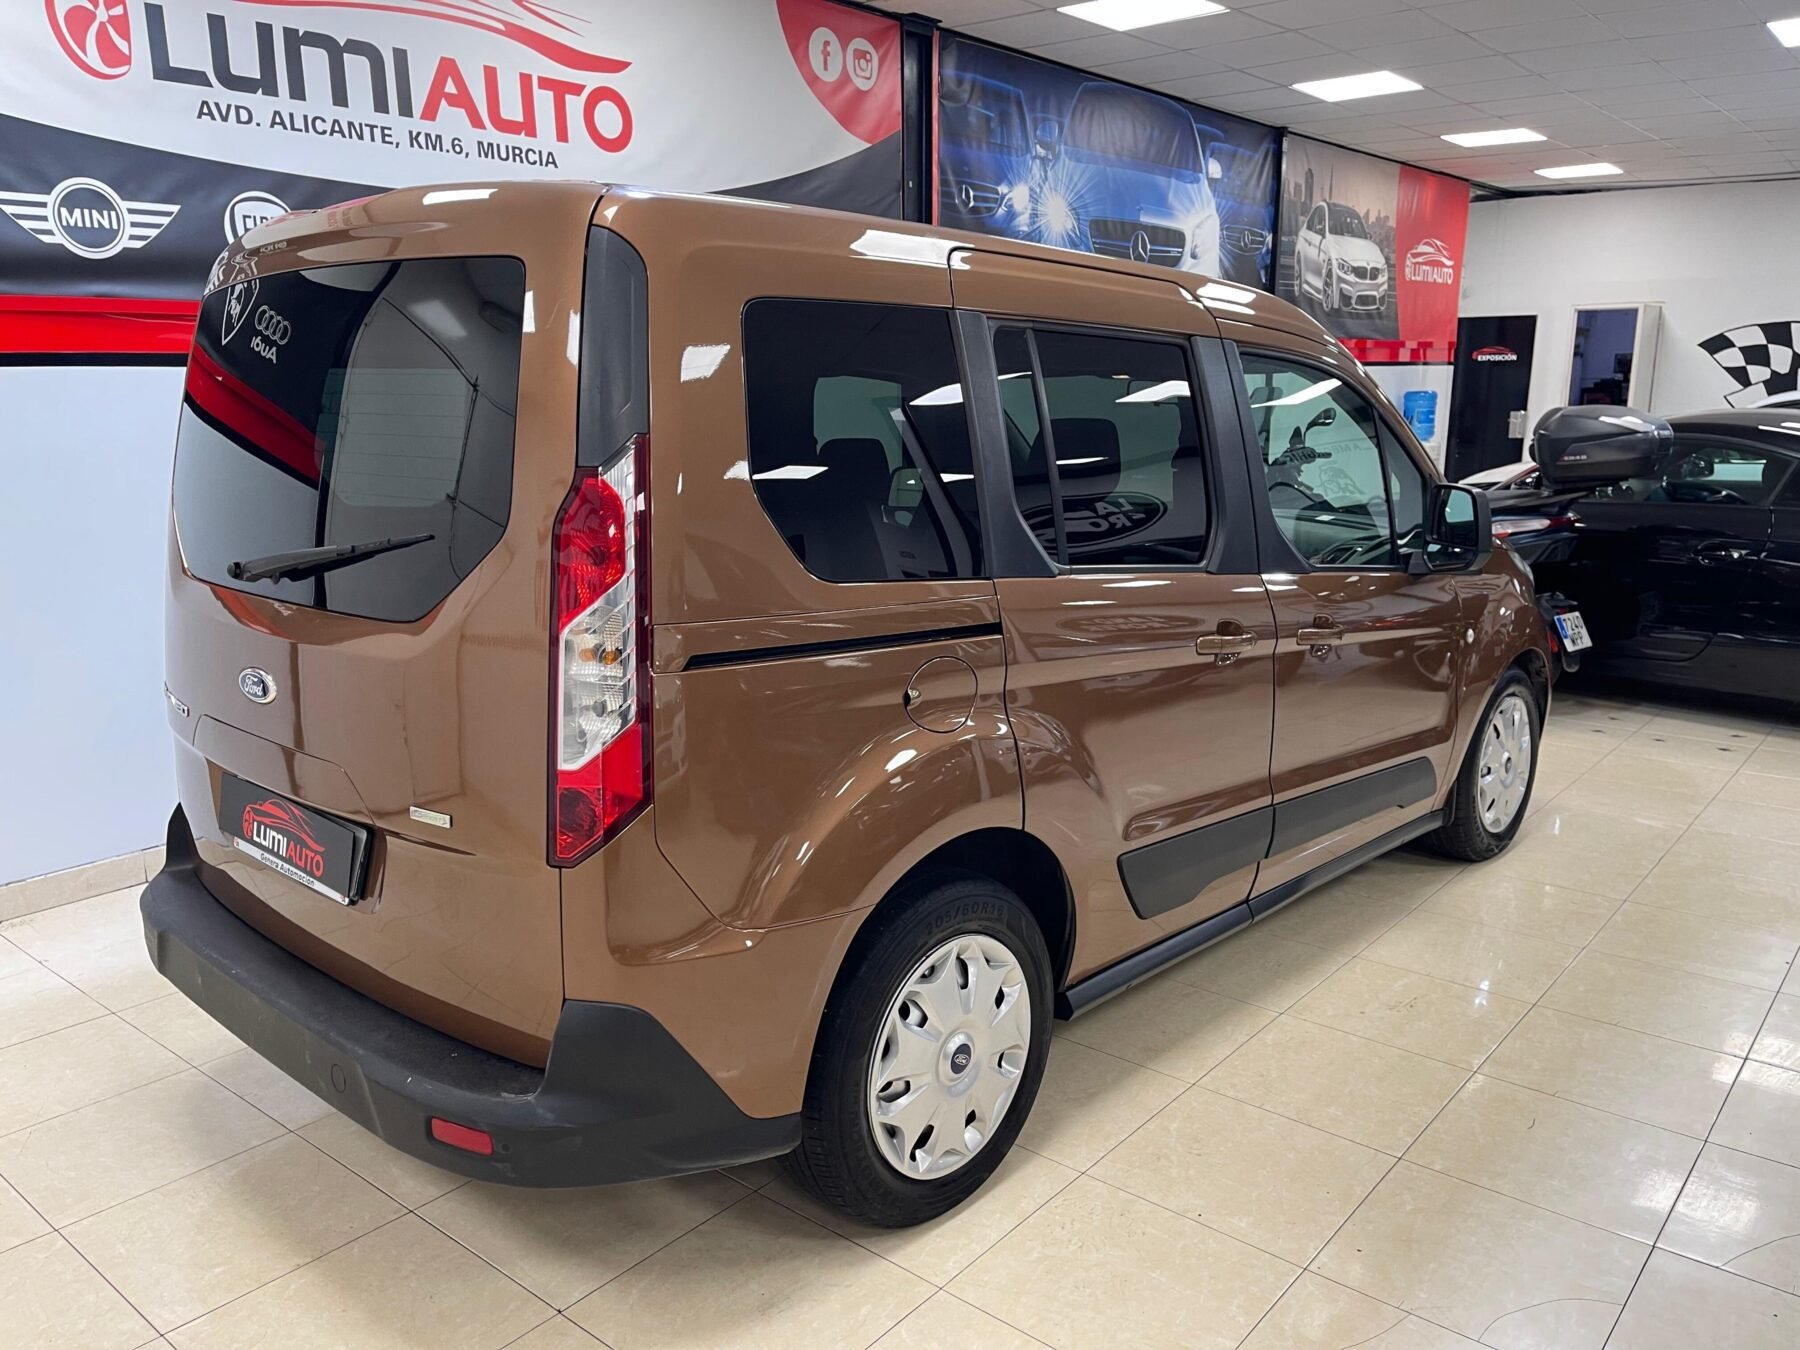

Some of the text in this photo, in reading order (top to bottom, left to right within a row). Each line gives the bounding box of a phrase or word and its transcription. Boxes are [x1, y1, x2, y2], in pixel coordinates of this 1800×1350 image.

[196, 99, 559, 169] AVD. ALICANTE, KM.6, MURCIA
[60, 205, 119, 230] MINI
[242, 214, 275, 233] FI
[244, 674, 264, 697] Ford
[260, 852, 280, 870] Genera
